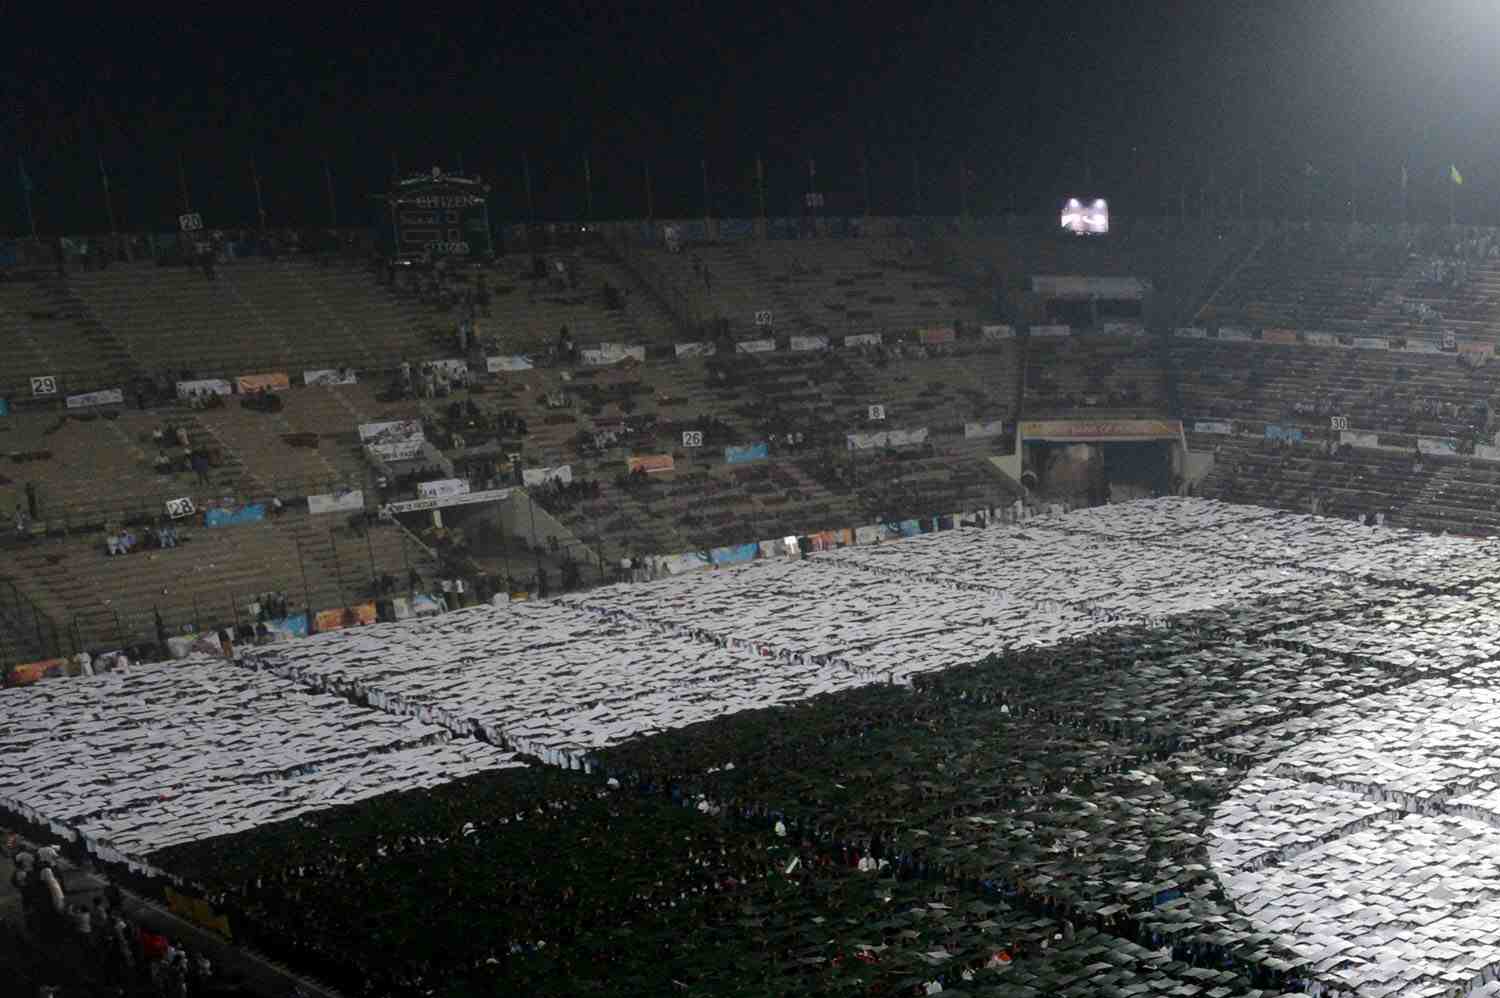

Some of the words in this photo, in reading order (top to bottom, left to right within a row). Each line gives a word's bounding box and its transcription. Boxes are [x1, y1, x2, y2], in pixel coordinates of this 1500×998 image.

[34, 378, 55, 393] 29
[685, 432, 700, 446] 26
[170, 499, 191, 517] 28
